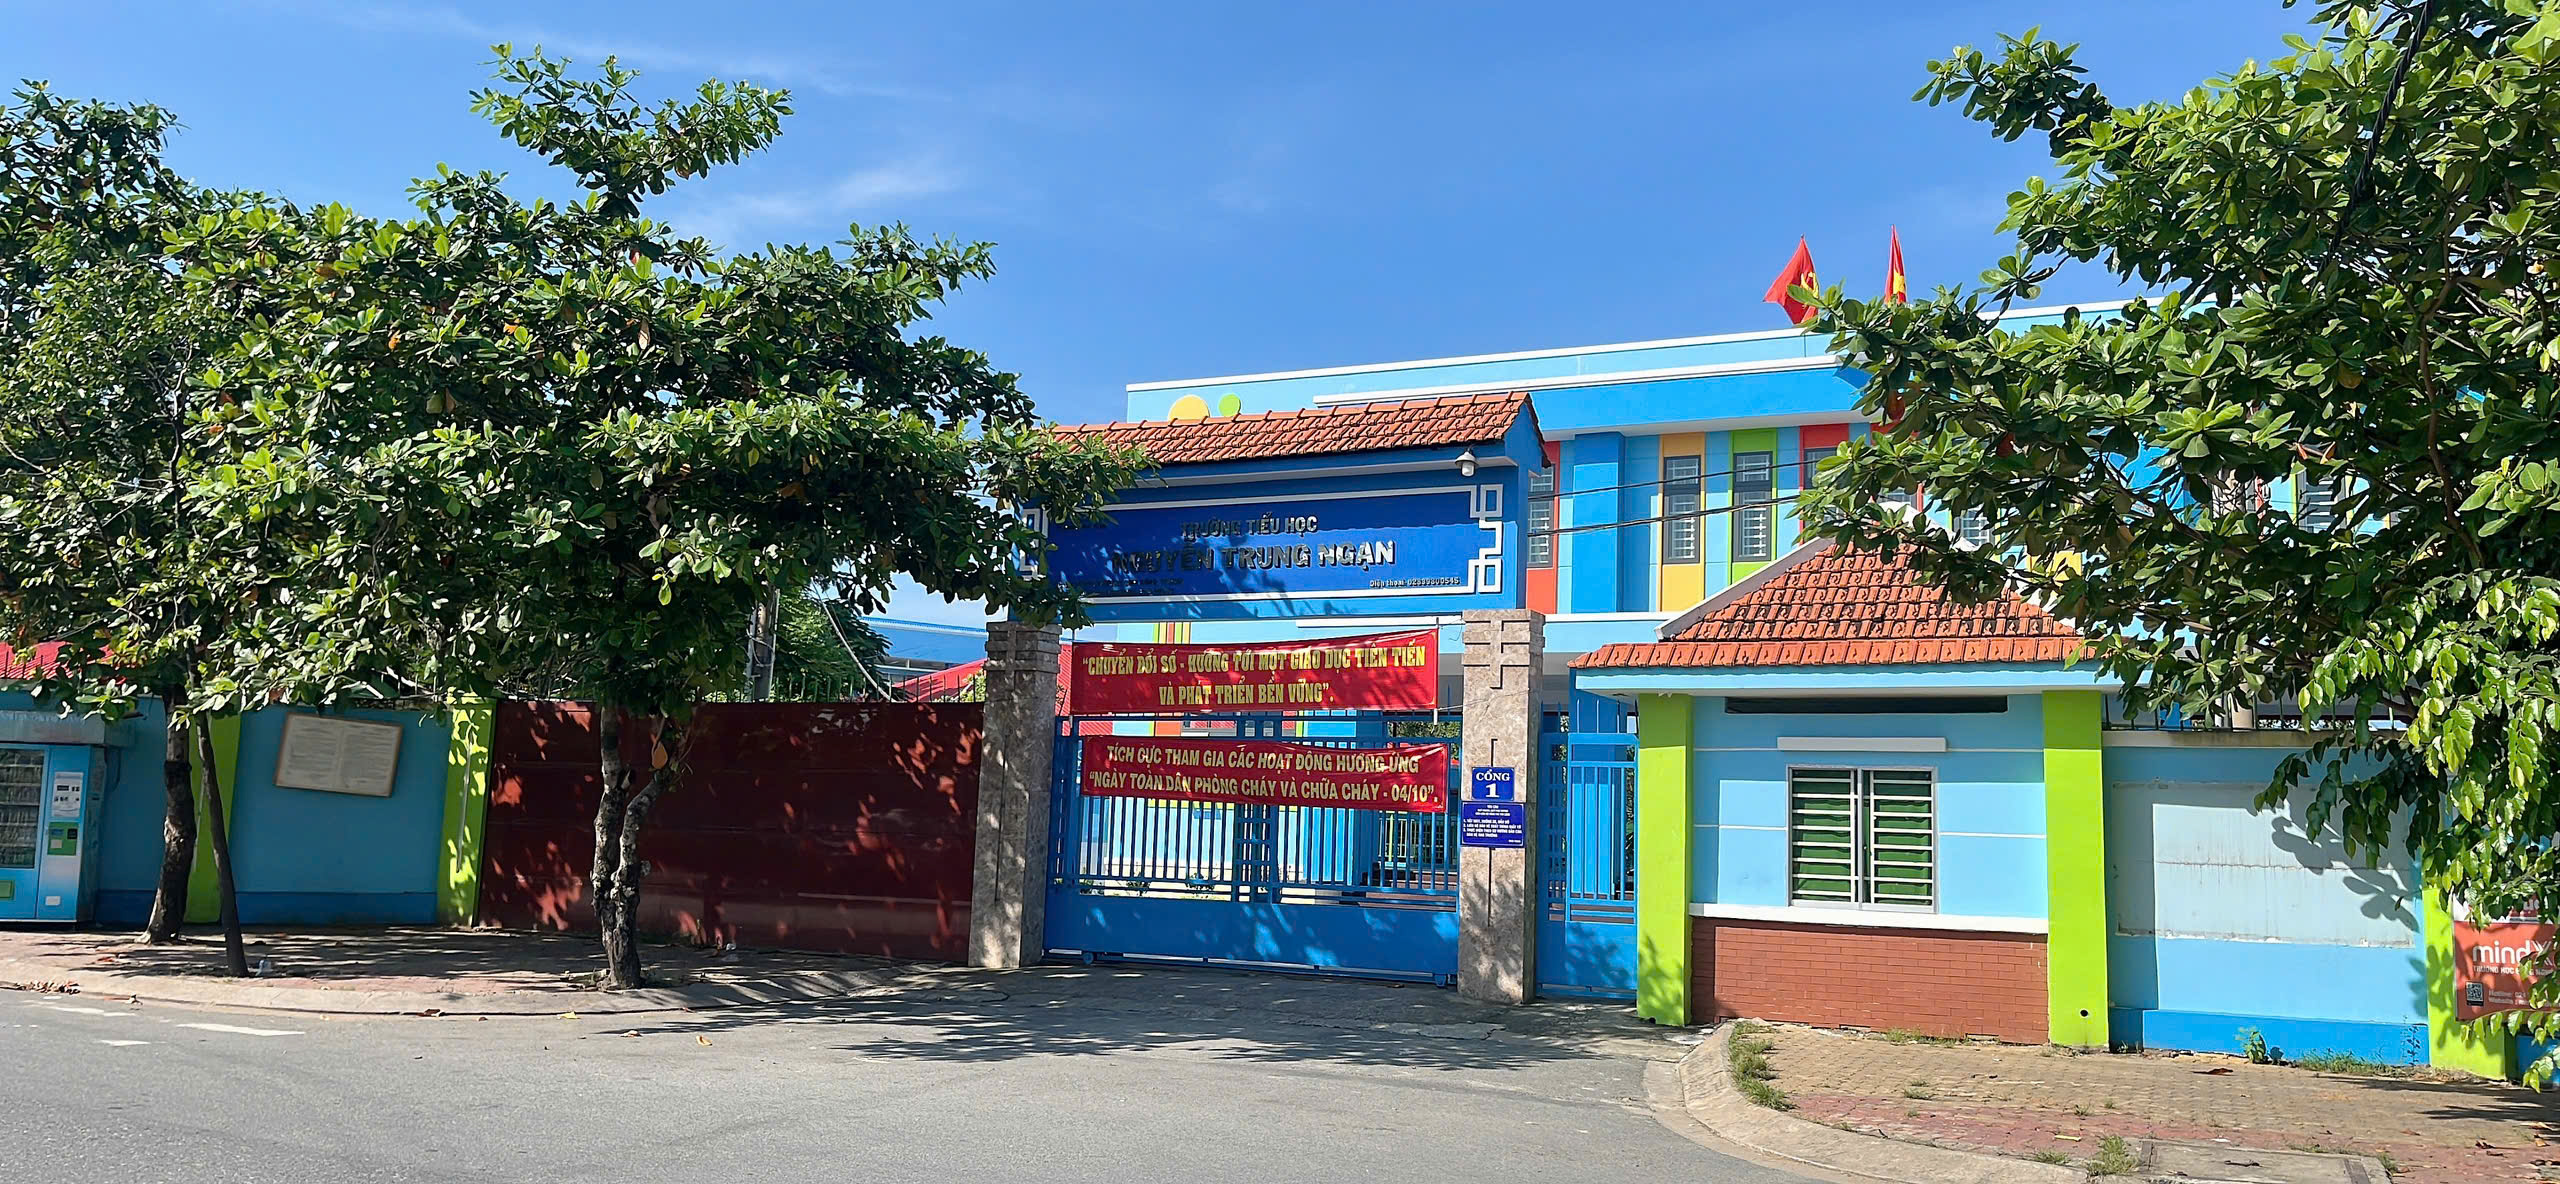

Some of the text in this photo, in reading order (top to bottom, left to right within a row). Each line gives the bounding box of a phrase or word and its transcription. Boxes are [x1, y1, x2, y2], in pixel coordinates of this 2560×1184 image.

[1285, 515, 1318, 537] HỌC
[1222, 544, 1311, 571] TRUNG
[1318, 540, 1395, 572] NGẠN
[1137, 648, 1158, 674] ĐỔI
[1161, 649, 1178, 674] SỐ
[1188, 649, 1229, 673] HƯỚNG
[1233, 648, 1255, 672] TỚI
[1259, 648, 1288, 676] MỘT
[1290, 646, 1321, 670] GIÁO
[1325, 648, 1351, 674] DỤC
[1355, 642, 1388, 668] TIÊN
[1392, 638, 1426, 667] TIẾN
[1158, 680, 1175, 706] VÀ
[1178, 680, 1212, 706] PHÁT
[1215, 675, 1255, 705] TRIỂN
[1258, 676, 1284, 704] BỀN
[1107, 742, 1419, 775] TÍCH CỰC THAM GIA CÁC HOẠT ĐỘNG HƯỚNG ỨNG
[1130, 769, 1162, 791] TOÀN
[1165, 771, 1192, 792] DÂN
[1194, 773, 1238, 795] PHÒNG
[1241, 775, 1277, 798] CHÁY
[1280, 776, 1298, 798] VÀ
[1301, 777, 1338, 800] CHỮA
[1341, 779, 1380, 801] CHÁY
[1475, 768, 1511, 781] CỔNG
[1485, 782, 1500, 798] 1
